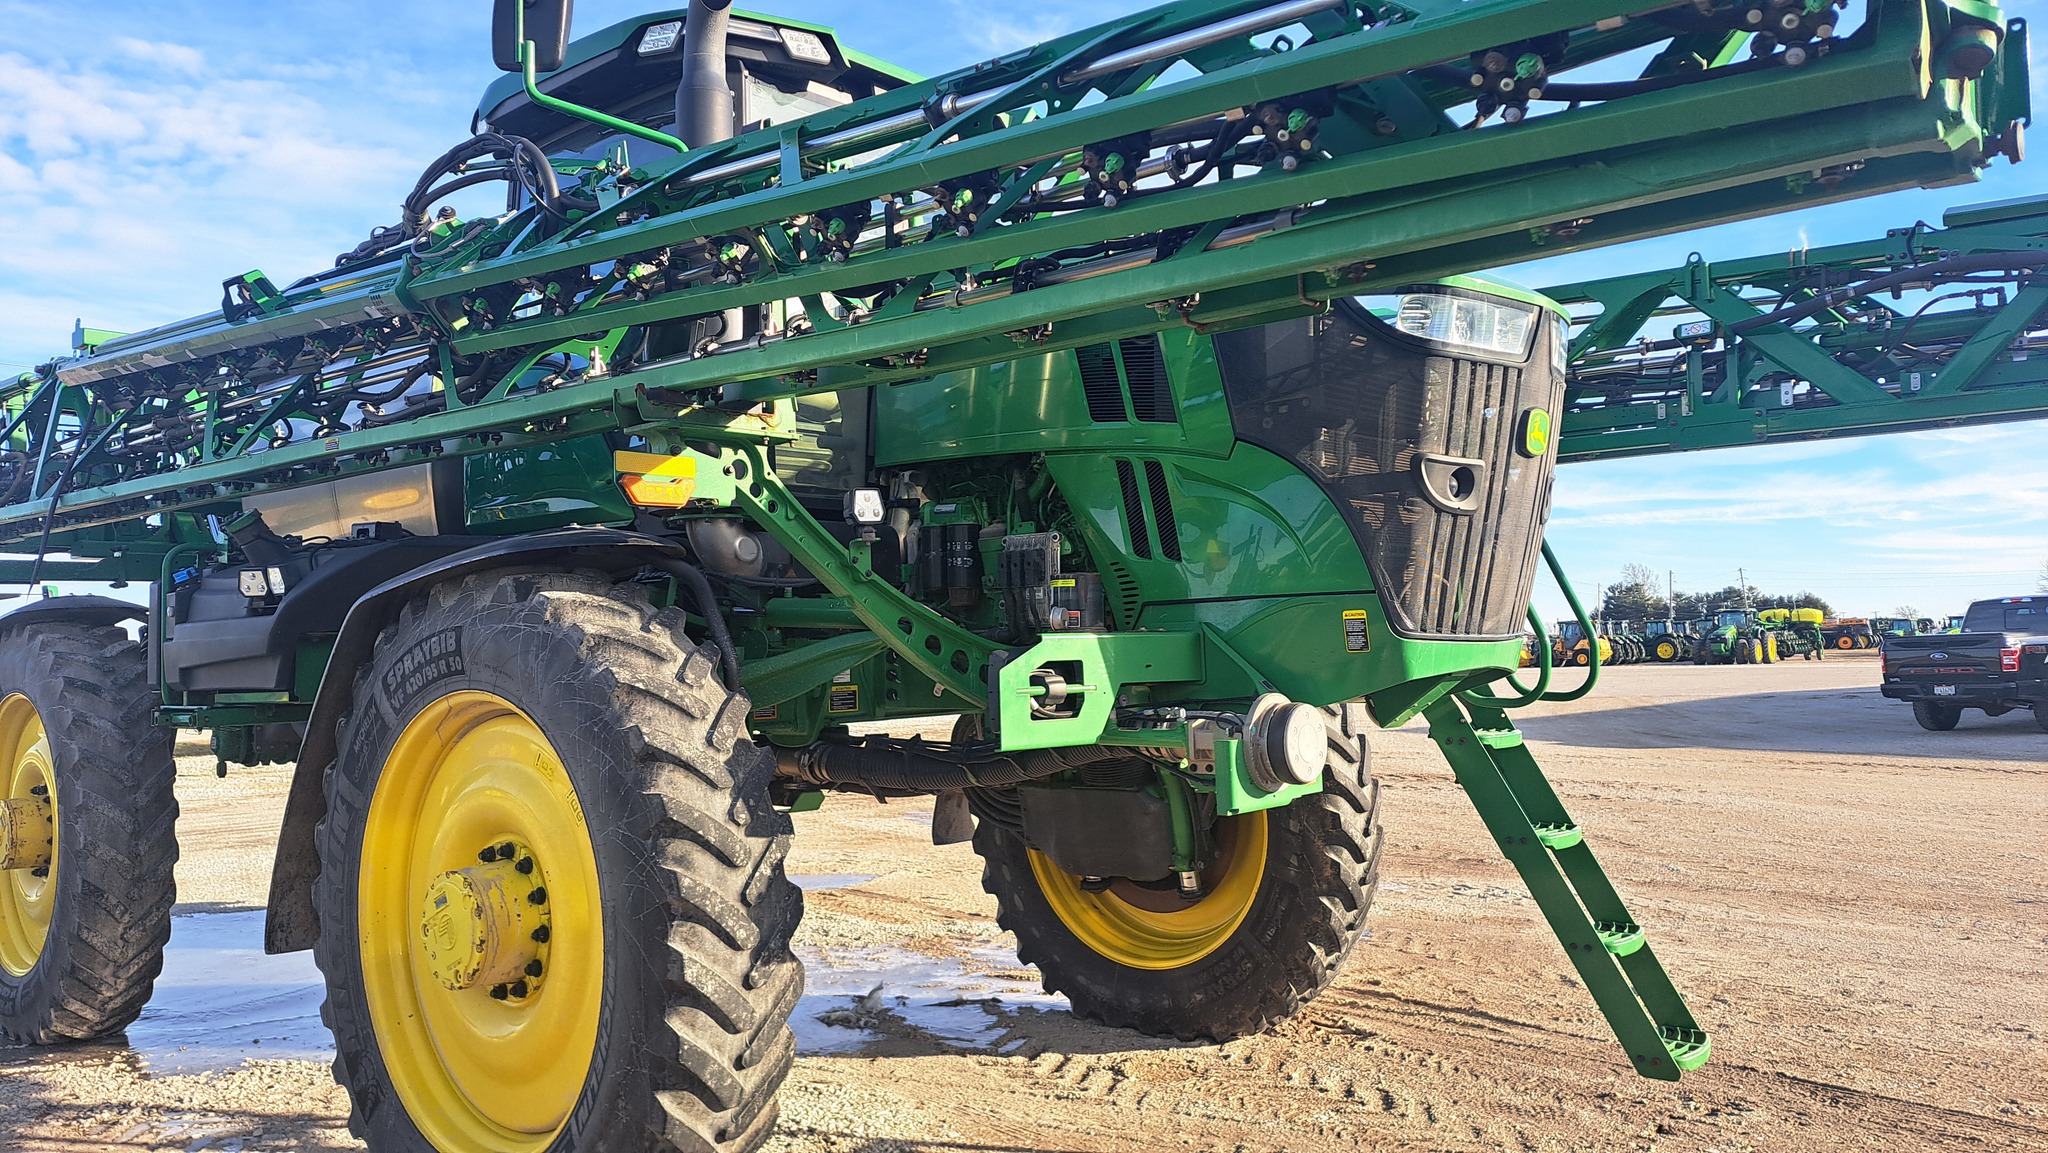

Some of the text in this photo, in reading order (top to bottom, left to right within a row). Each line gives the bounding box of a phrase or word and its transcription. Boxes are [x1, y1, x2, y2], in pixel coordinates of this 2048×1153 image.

[386, 630, 457, 692] SPRAYBIB
[390, 688, 404, 710] VF
[404, 661, 439, 695] 420/95
[438, 659, 448, 675] R
[449, 655, 463, 672] 50
[353, 705, 378, 753] MICHELIN
[574, 955, 617, 1137] MICHELIN
